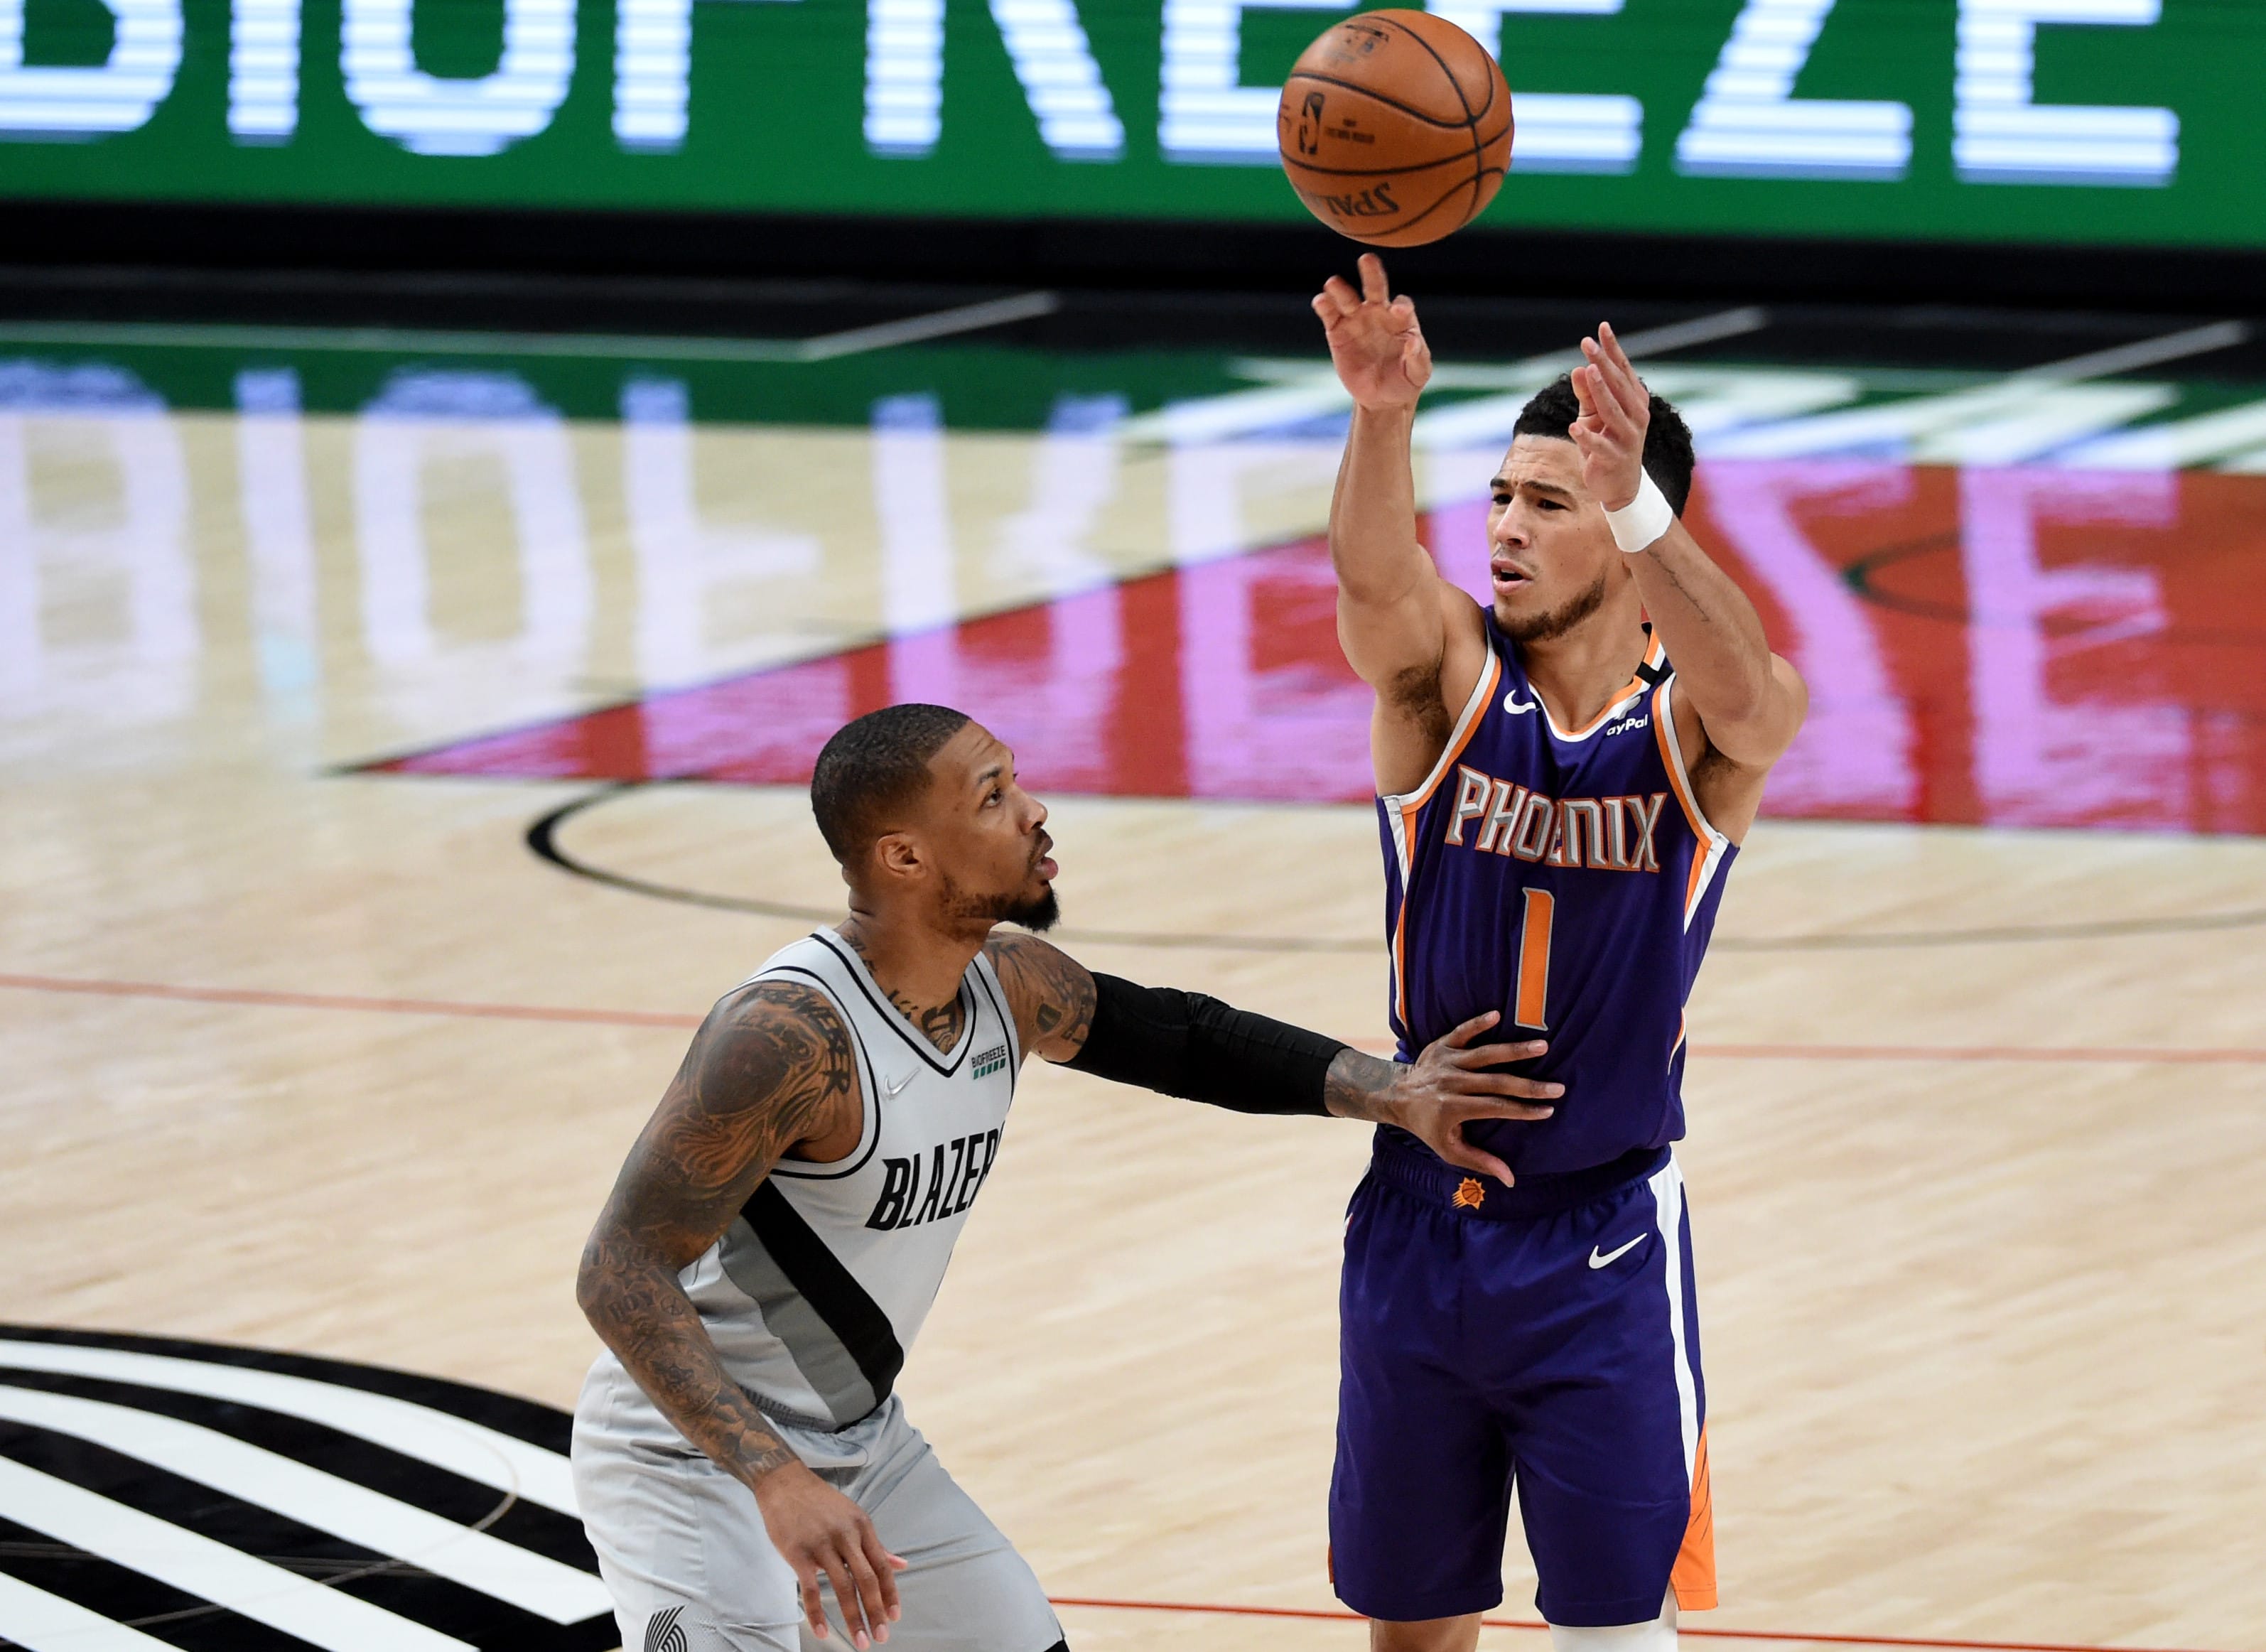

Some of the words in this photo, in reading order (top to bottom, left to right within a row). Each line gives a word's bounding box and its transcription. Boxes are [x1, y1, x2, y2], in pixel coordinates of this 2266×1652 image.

[1606, 713, 1649, 736] ayPal
[1514, 886, 1556, 1031] 1
[971, 1044, 1006, 1068] BIOFREEZE
[864, 1128, 999, 1231] BLAZER
